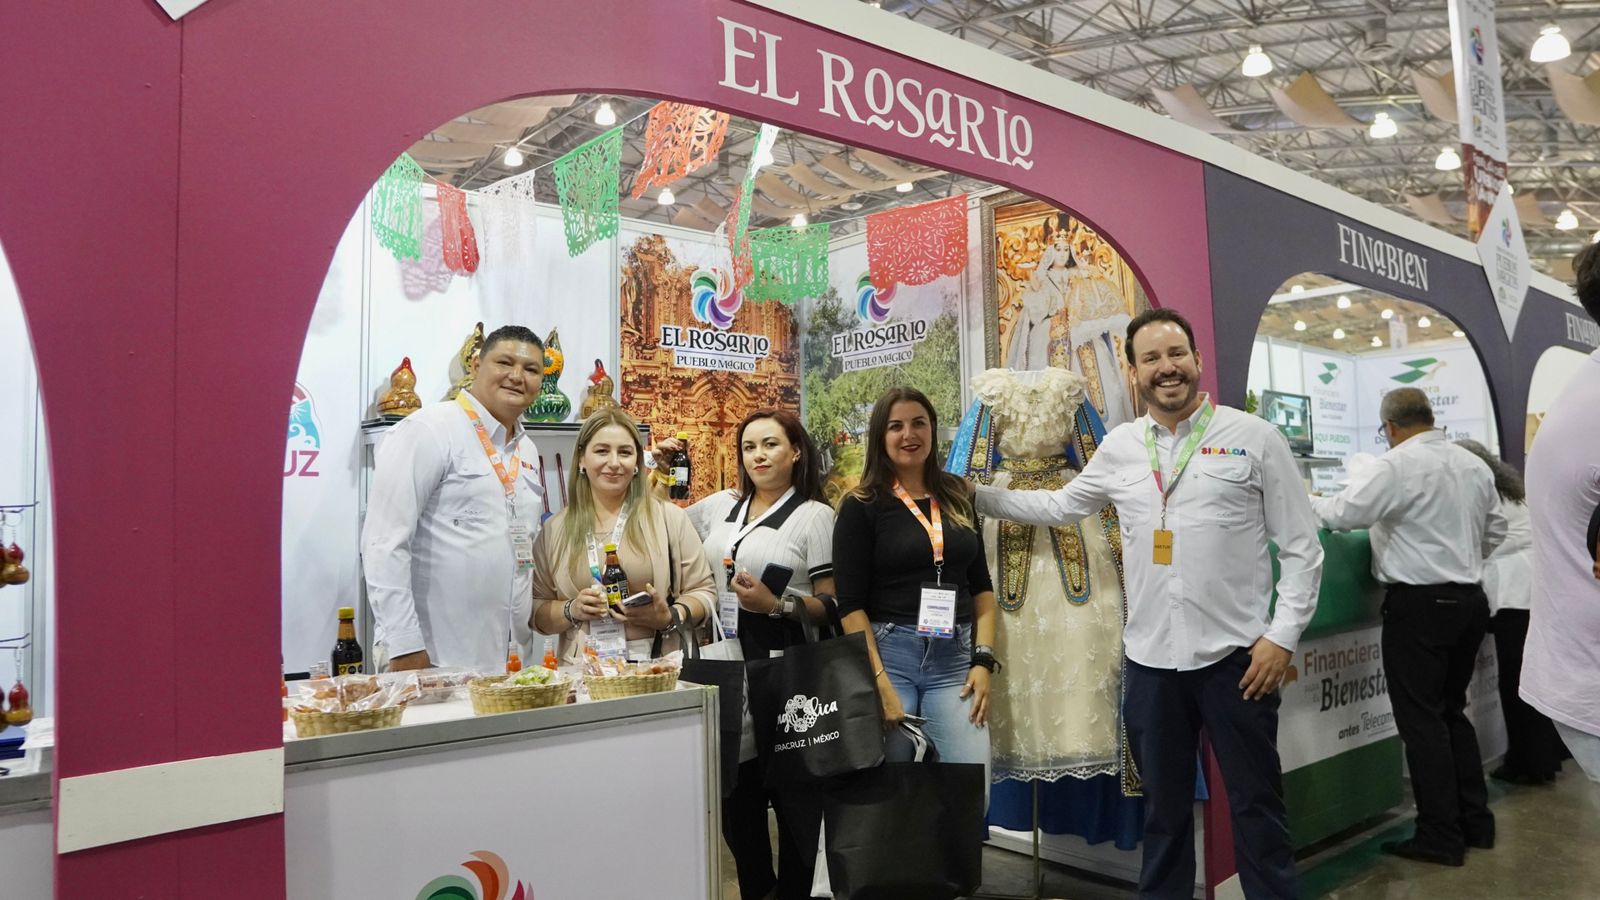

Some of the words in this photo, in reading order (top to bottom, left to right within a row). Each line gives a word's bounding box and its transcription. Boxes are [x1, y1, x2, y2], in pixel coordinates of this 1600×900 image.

[717, 16, 799, 106] EL
[661, 326, 686, 347] EL
[833, 334, 851, 355] EL
[1200, 447, 1247, 457] SINALOA
[1304, 640, 1380, 676] Financiera
[813, 730, 840, 745] MÉXICO
[1338, 725, 1360, 740] antes
